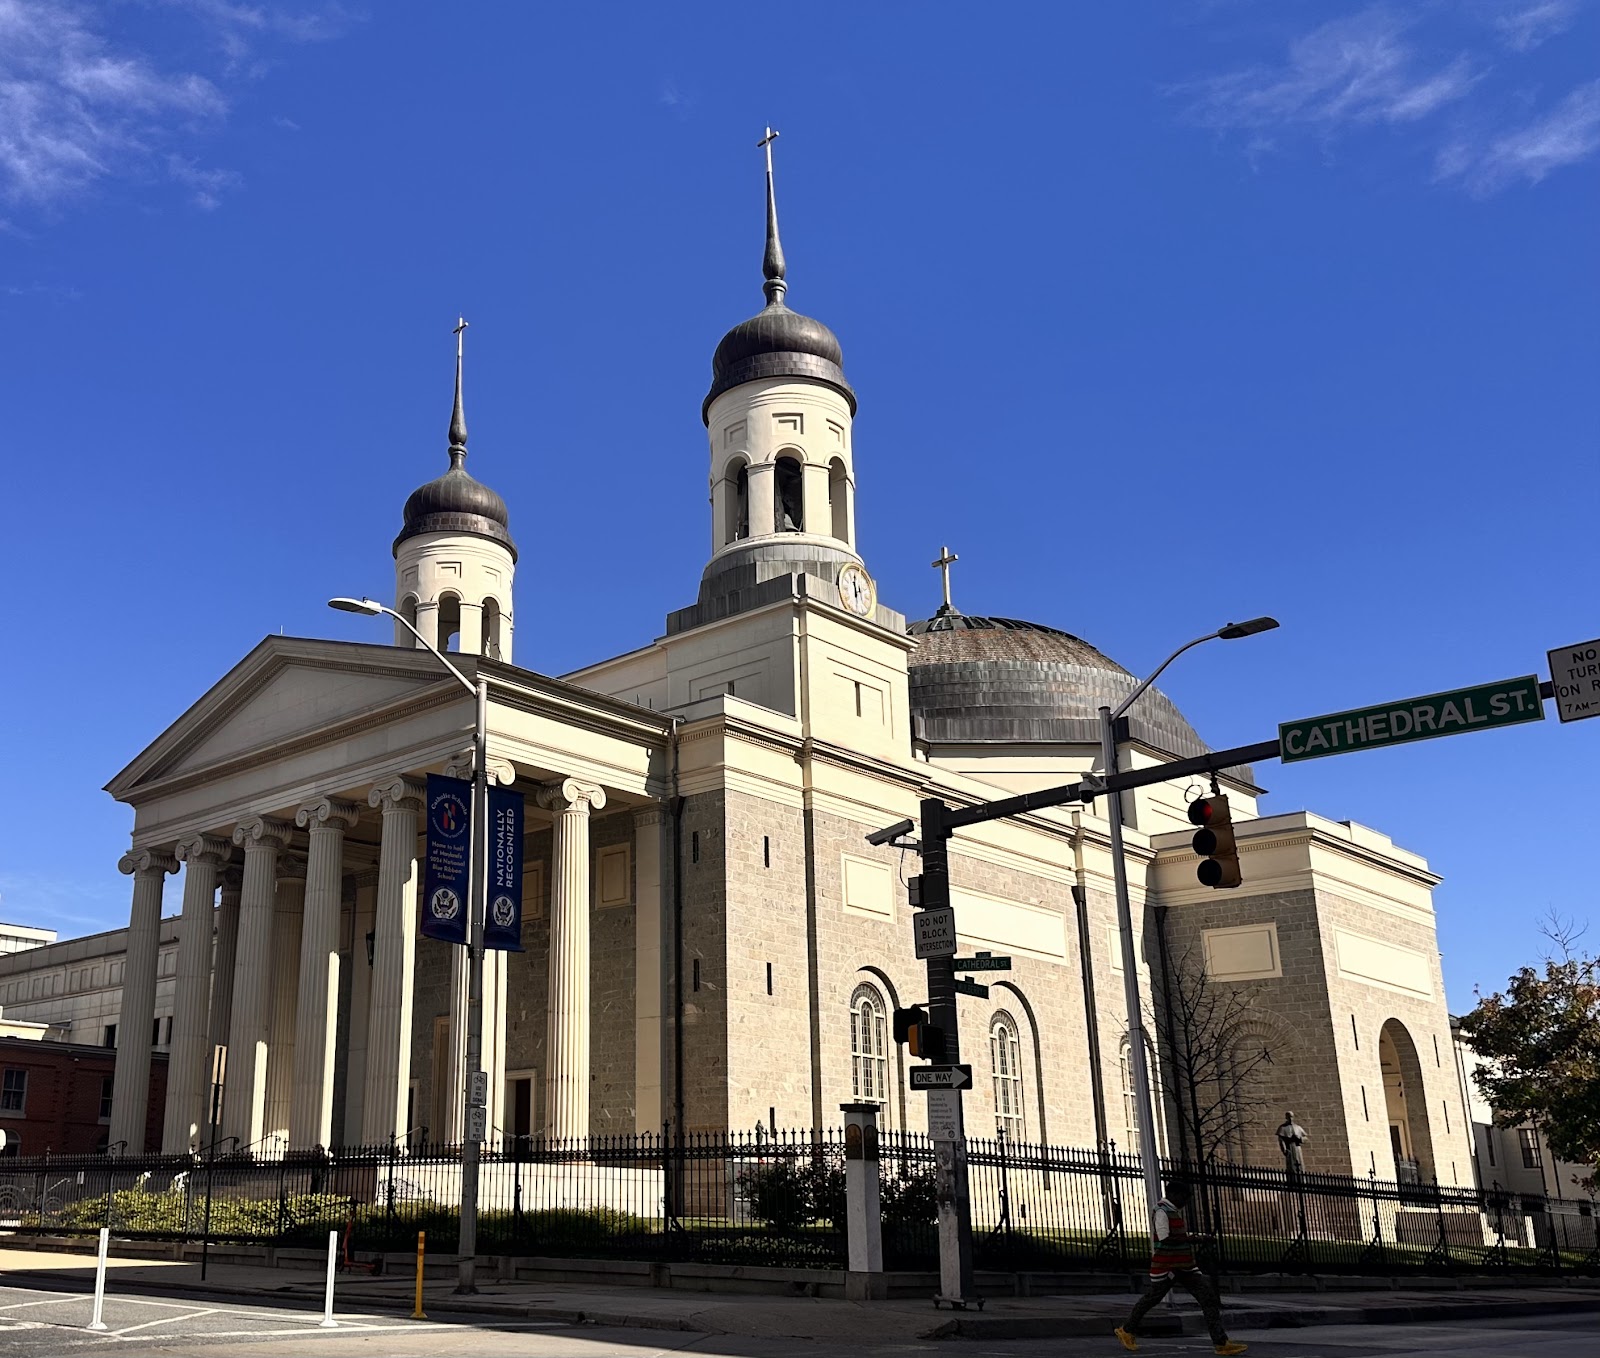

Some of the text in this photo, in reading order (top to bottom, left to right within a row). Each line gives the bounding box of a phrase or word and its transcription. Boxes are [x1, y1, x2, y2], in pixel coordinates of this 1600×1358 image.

[1572, 649, 1597, 664] NO
[1560, 683, 1580, 698] ON
[1286, 689, 1536, 755] CATHEDRAL ST.
[451, 794, 467, 815] Schools
[432, 841, 446, 849] Home
[506, 808, 514, 888] RECOGNIZED
[920, 915, 948, 928] DO NOT
[922, 928, 948, 939] BLOCK
[957, 959, 1000, 970] CATHEDRAL
[916, 1072, 952, 1083] ONE WAY
